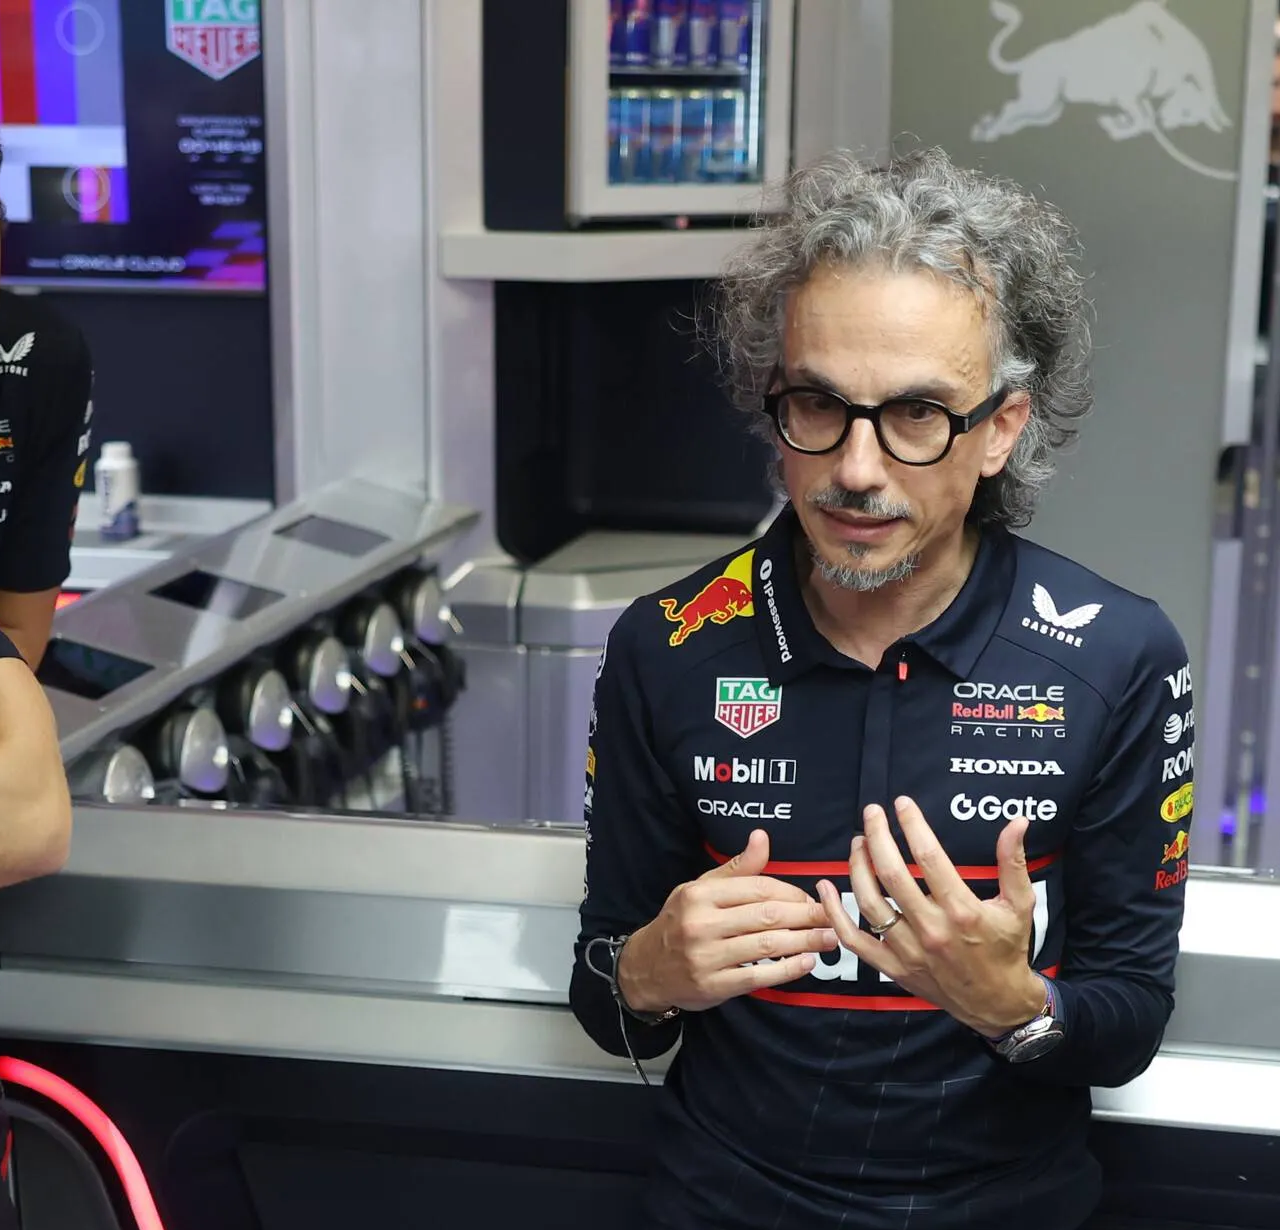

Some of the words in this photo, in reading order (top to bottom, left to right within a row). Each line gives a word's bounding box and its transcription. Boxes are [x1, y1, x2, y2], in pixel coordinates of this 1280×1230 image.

[763, 579, 793, 665] 1Password
[1021, 617, 1084, 649] CASTORE
[722, 681, 777, 701] TAG
[952, 681, 1065, 702] ORACLE
[1164, 662, 1193, 700] VIS
[719, 703, 778, 733] HEUER
[952, 703, 983, 720] Red
[984, 703, 1014, 720] Bull
[951, 724, 1067, 739] RACING
[694, 755, 764, 784] Mobil
[950, 757, 1065, 776] HONDA
[697, 798, 793, 820] ORACLE
[977, 794, 1058, 822] Gate
